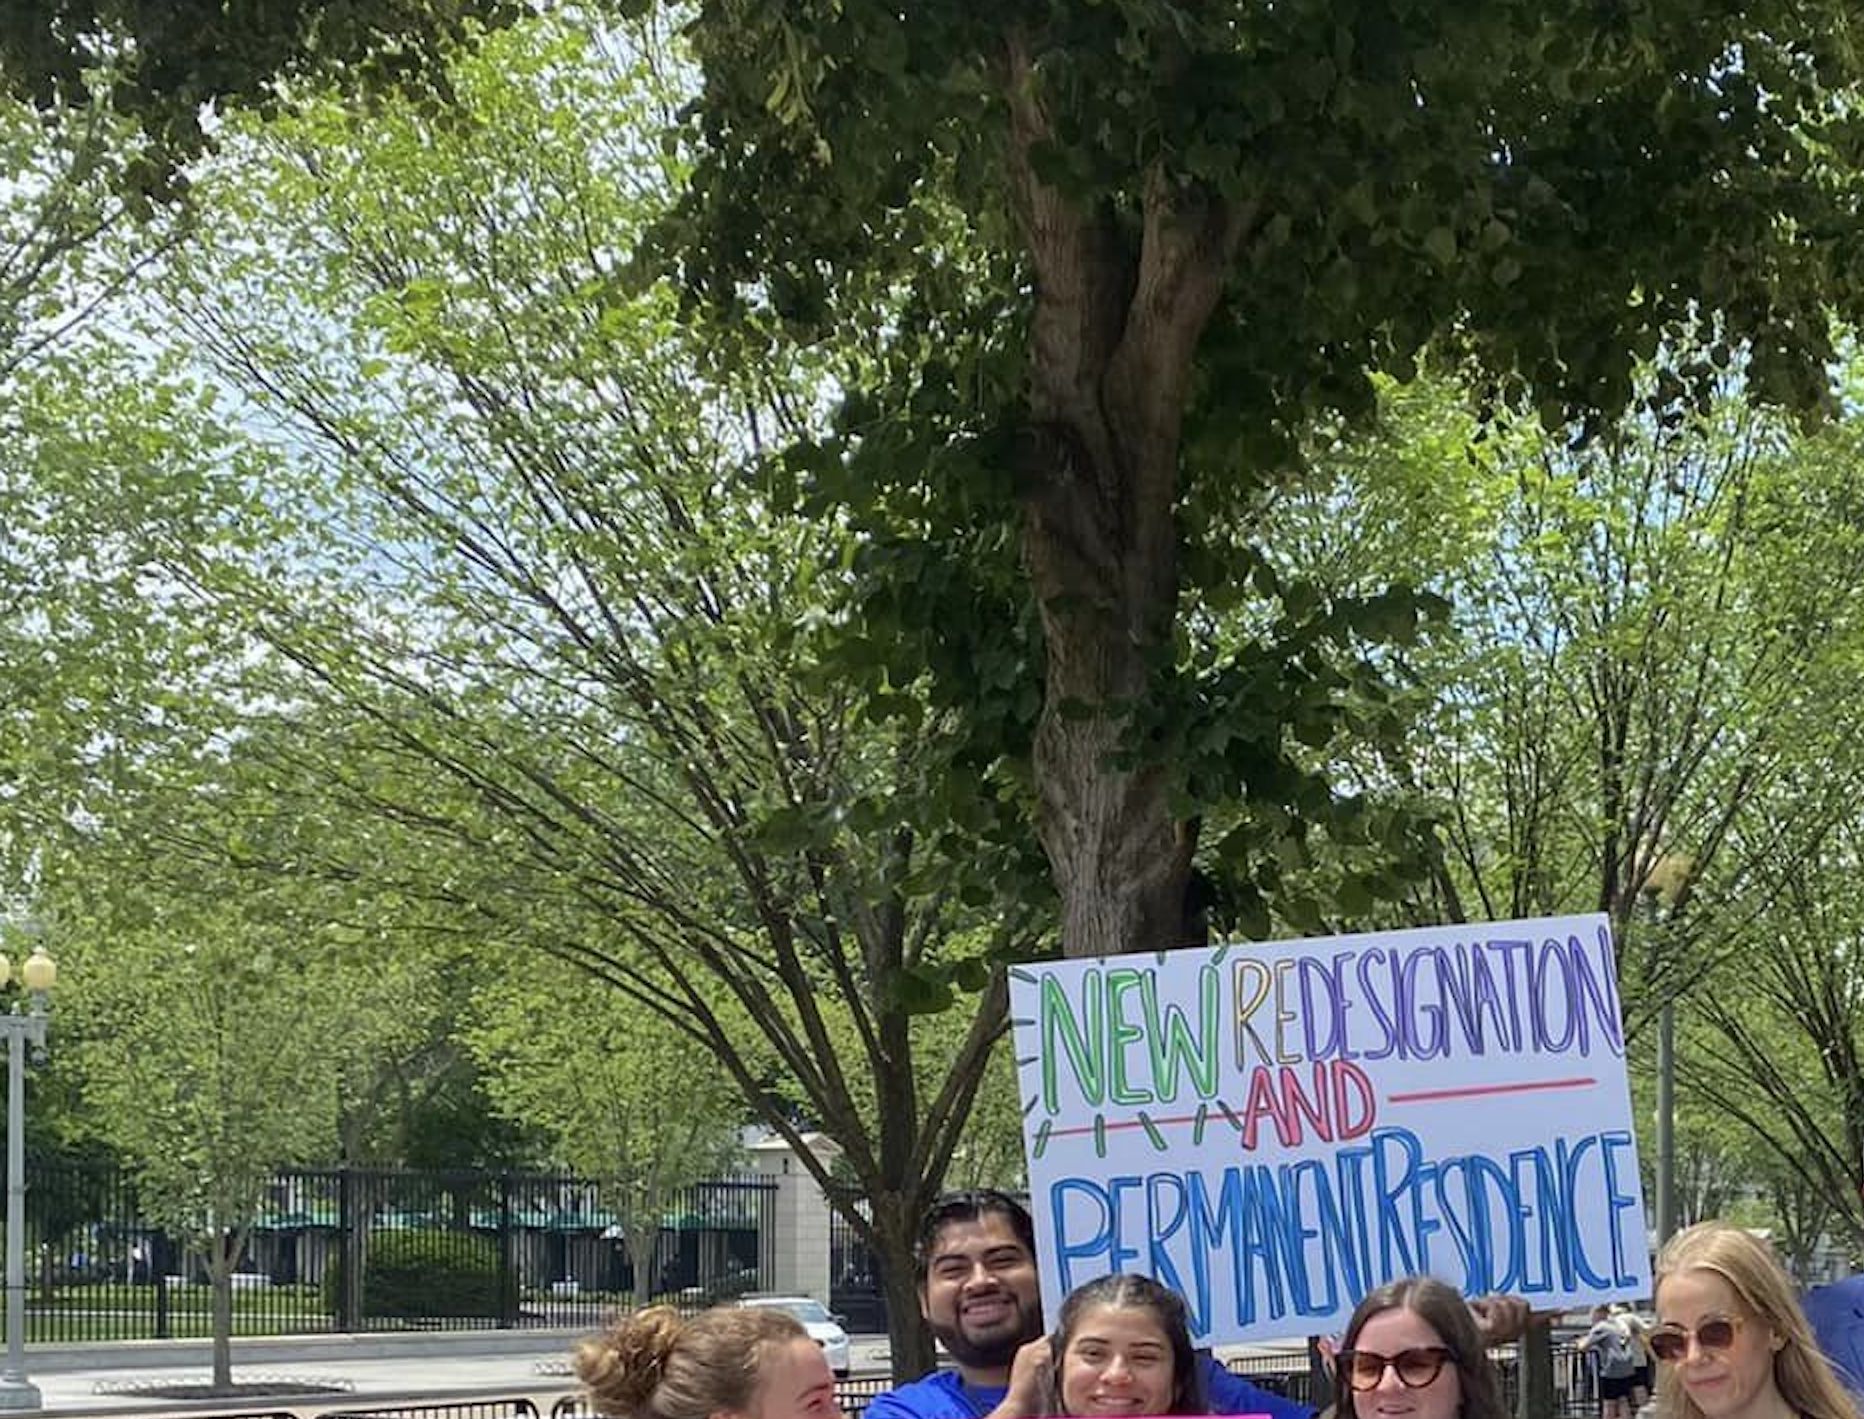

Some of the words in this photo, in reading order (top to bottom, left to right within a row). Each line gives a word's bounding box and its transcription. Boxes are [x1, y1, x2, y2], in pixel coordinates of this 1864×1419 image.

[1040, 964, 1219, 1114] NEW
[1231, 925, 1625, 1072] REDESIGNATION
[1241, 1060, 1376, 1150] AND
